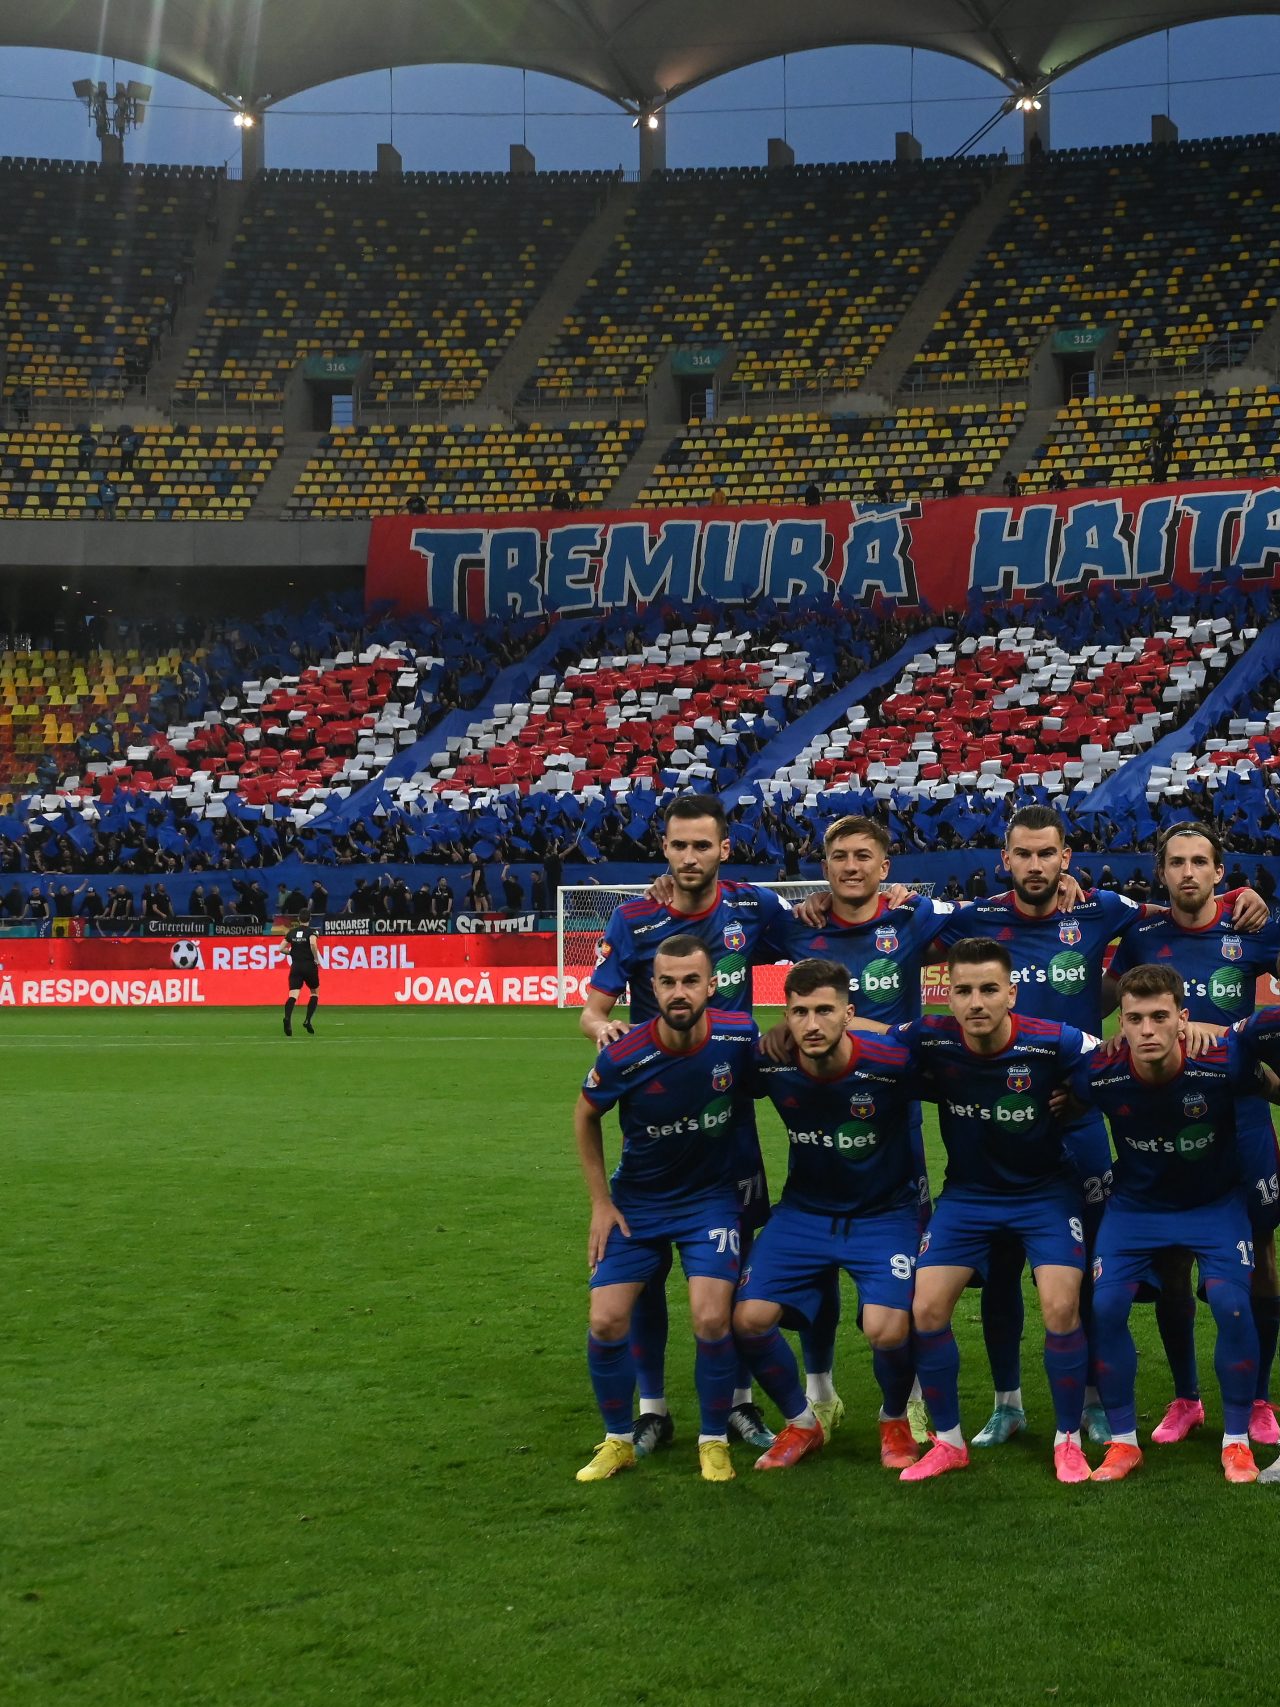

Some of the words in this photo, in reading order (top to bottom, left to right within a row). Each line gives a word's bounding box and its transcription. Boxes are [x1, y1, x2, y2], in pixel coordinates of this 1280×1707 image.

[1073, 335, 1093, 344] 312
[326, 363, 346, 372] 316
[692, 355, 711, 366] 314
[410, 499, 922, 620] TREMURĂ
[324, 918, 370, 930] BUCHAREST
[375, 918, 447, 933] OUTLAWS
[213, 943, 415, 970] RESPNSABIL
[717, 966, 747, 988] bet
[866, 972, 899, 991] bet
[1009, 965, 1047, 984] et's
[1052, 964, 1086, 982] bet
[22, 977, 205, 1005] RESPONSABIL
[394, 971, 495, 1004] JOACĂ
[503, 975, 592, 1004] RESPO
[1183, 978, 1207, 997] t's
[1212, 979, 1242, 997] bet
[646, 1116, 699, 1139] get's
[704, 1105, 732, 1129] bet
[996, 1105, 1035, 1122] bet
[838, 1130, 877, 1149] bet
[1180, 1131, 1216, 1152] bet
[1256, 1173, 1280, 1206] 19
[708, 1227, 741, 1254] 70
